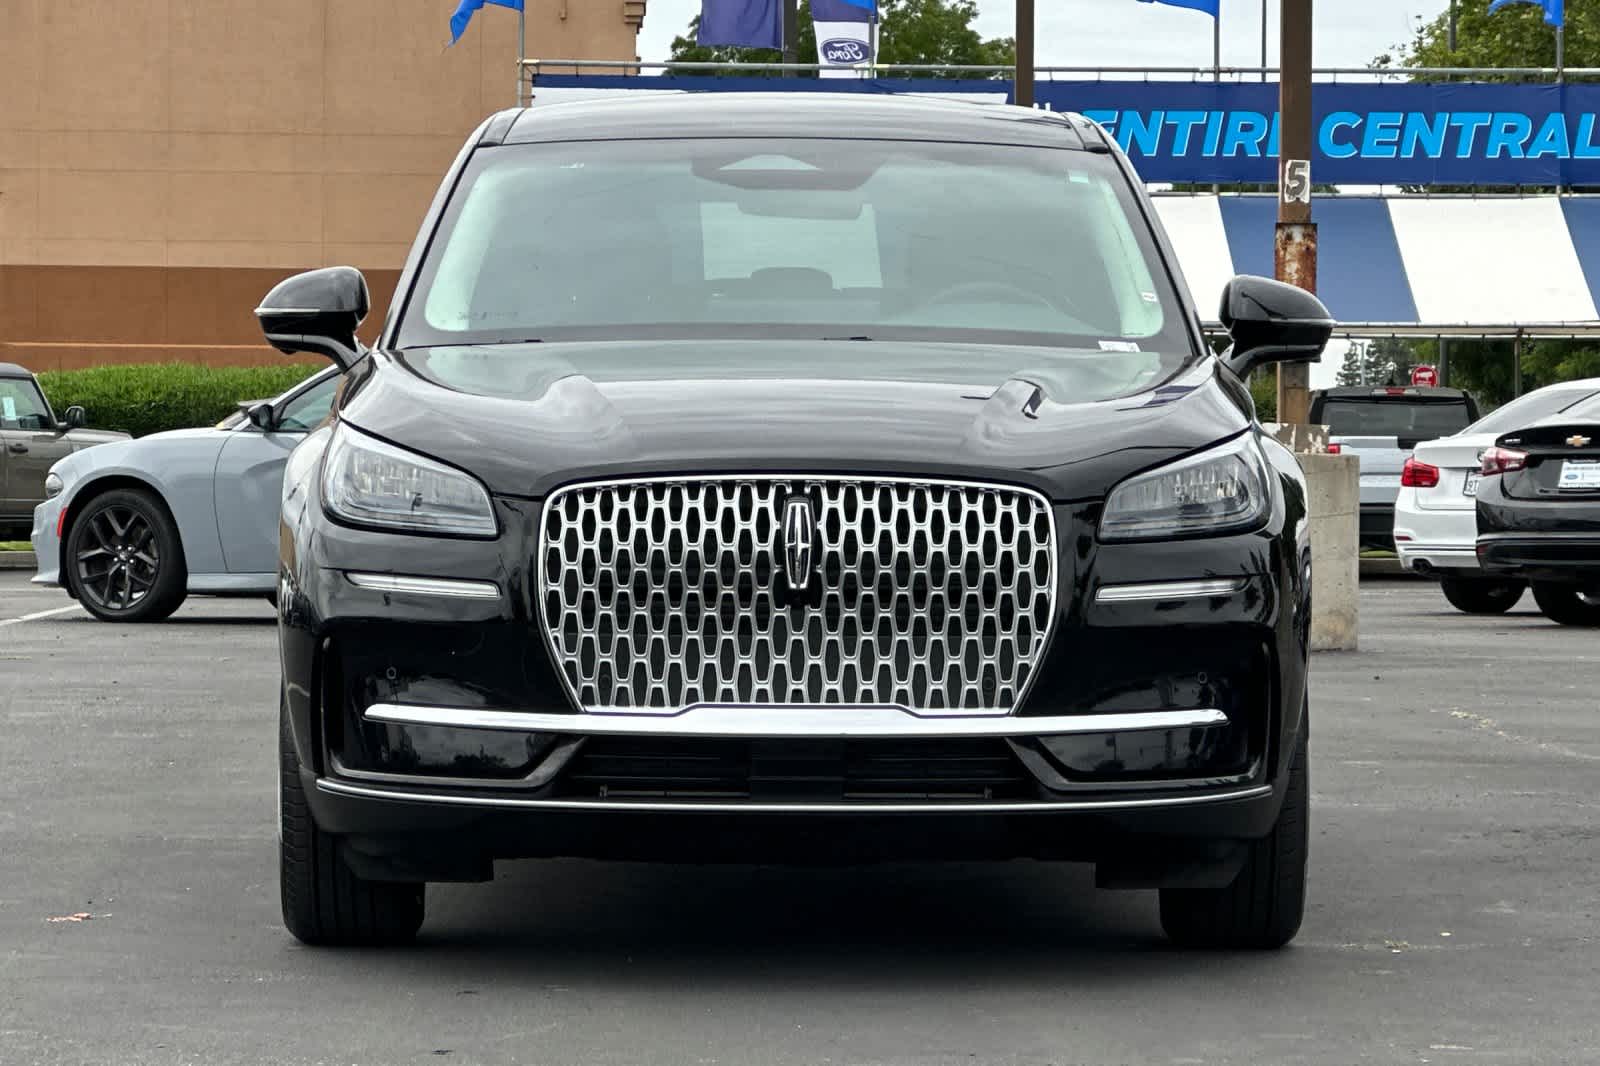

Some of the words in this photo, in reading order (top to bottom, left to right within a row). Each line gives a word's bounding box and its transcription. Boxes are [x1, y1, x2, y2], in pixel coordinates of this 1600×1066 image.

[1081, 110, 1281, 157] NTIR
[1318, 111, 1600, 159] CENTRAL
[1285, 161, 1307, 197] 5
